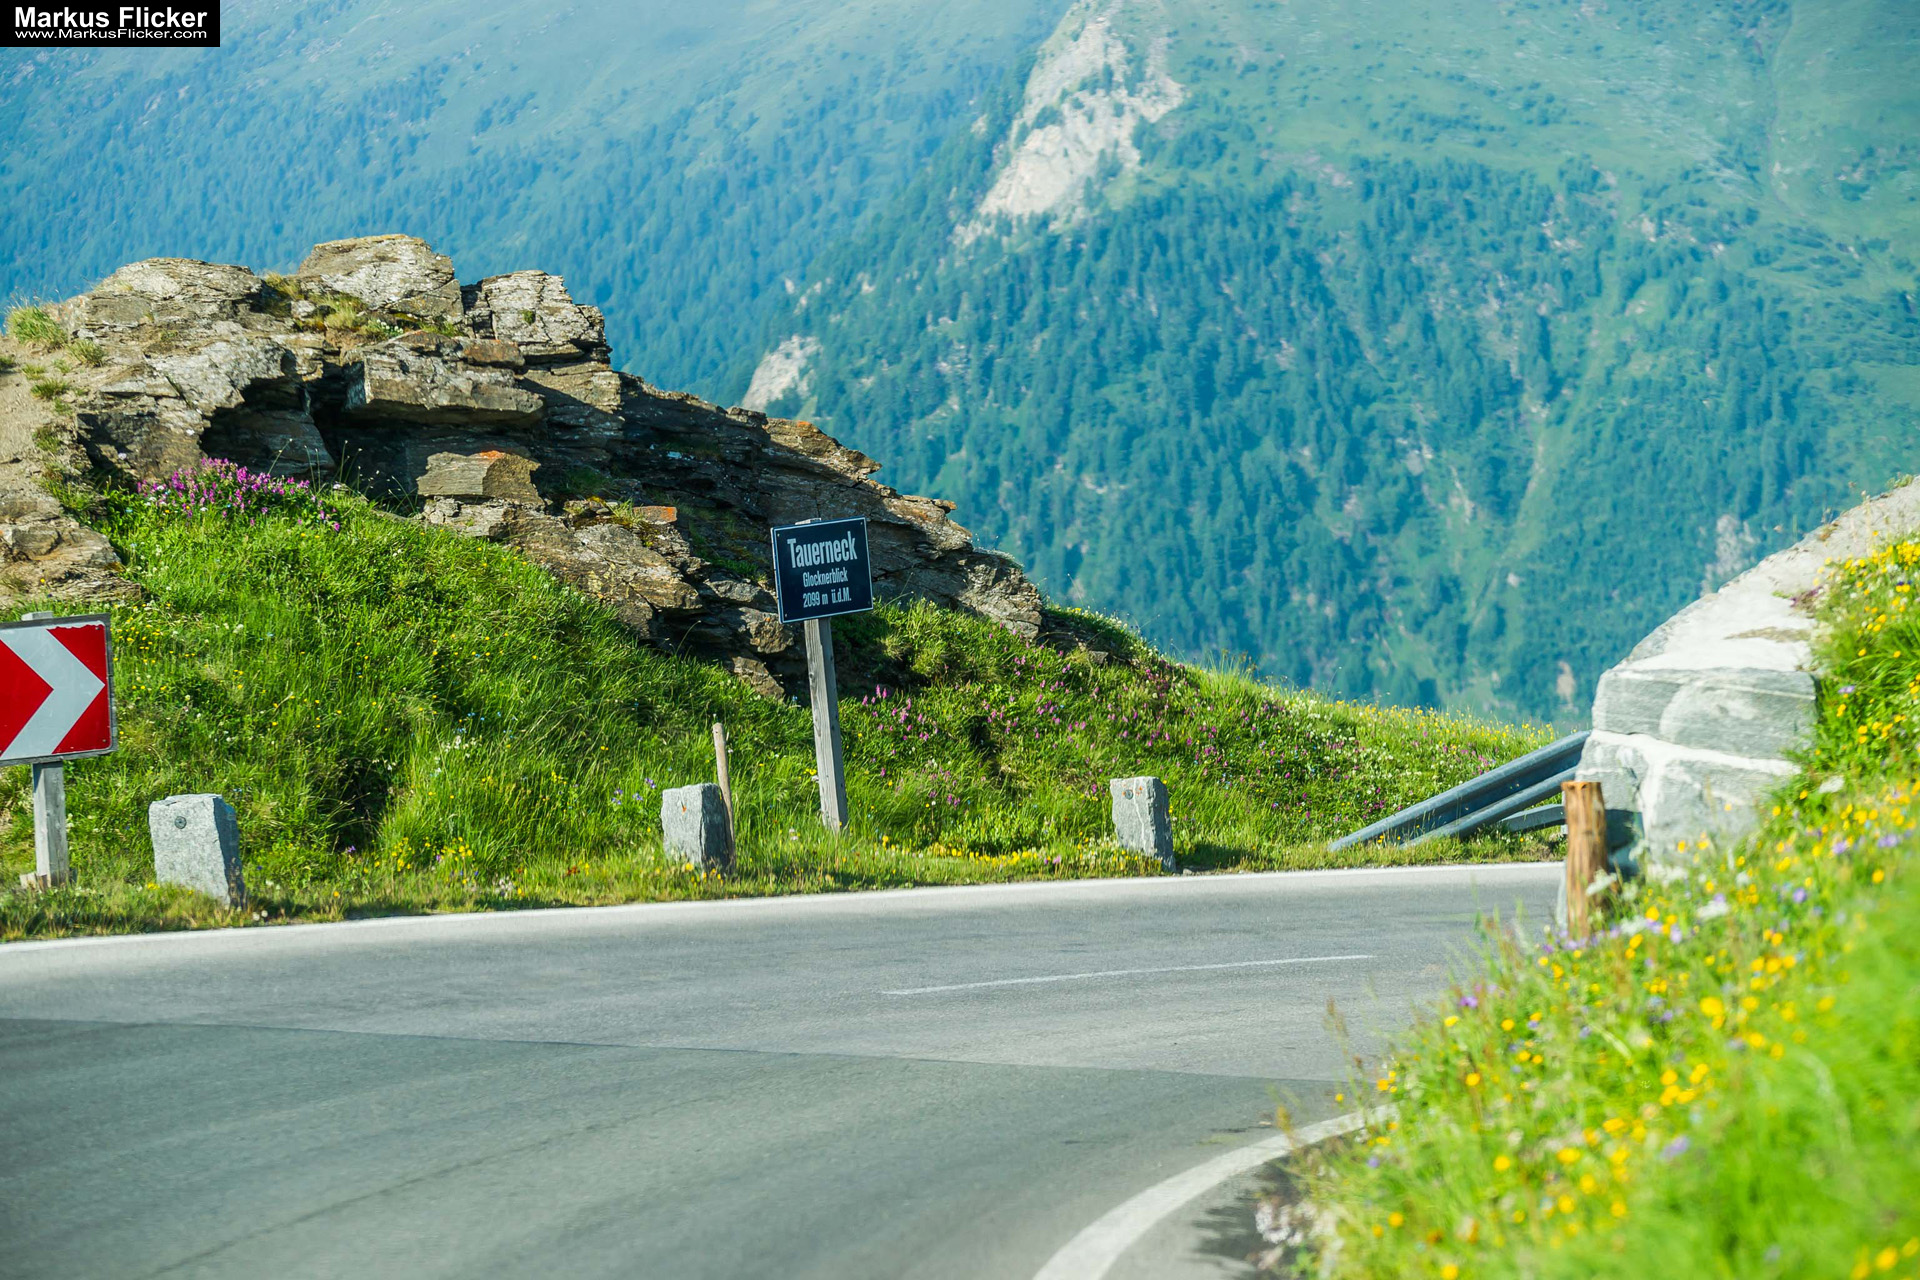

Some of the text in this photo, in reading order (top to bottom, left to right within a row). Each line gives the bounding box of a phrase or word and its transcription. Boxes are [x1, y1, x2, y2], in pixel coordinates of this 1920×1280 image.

[787, 530, 858, 568] Tauerneck
[802, 567, 848, 587] Glocknerblick
[802, 587, 852, 608] 2099 m ü.d.M.
